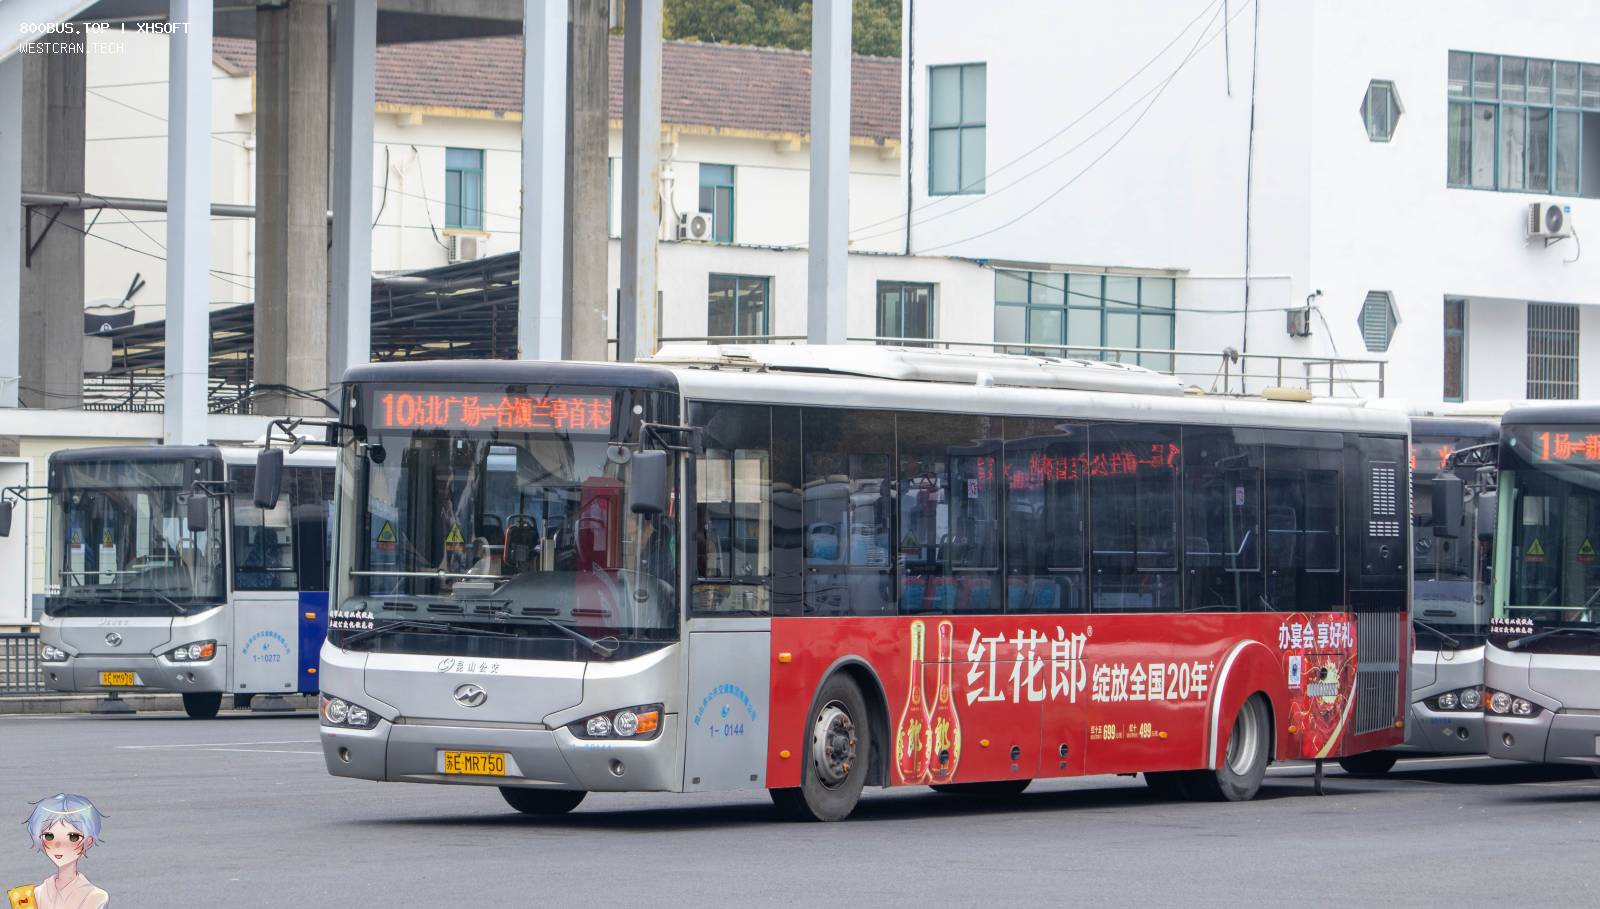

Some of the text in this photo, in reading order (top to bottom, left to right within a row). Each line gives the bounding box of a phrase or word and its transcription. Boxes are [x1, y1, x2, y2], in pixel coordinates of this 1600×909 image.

[382, 393, 415, 427] 10
[1539, 431, 1549, 460] 1
[1279, 622, 1353, 649] 办宴会 享好礼
[966, 625, 1087, 707] 红花郎
[1103, 724, 1116, 740] 699
[1139, 722, 1152, 739] 499
